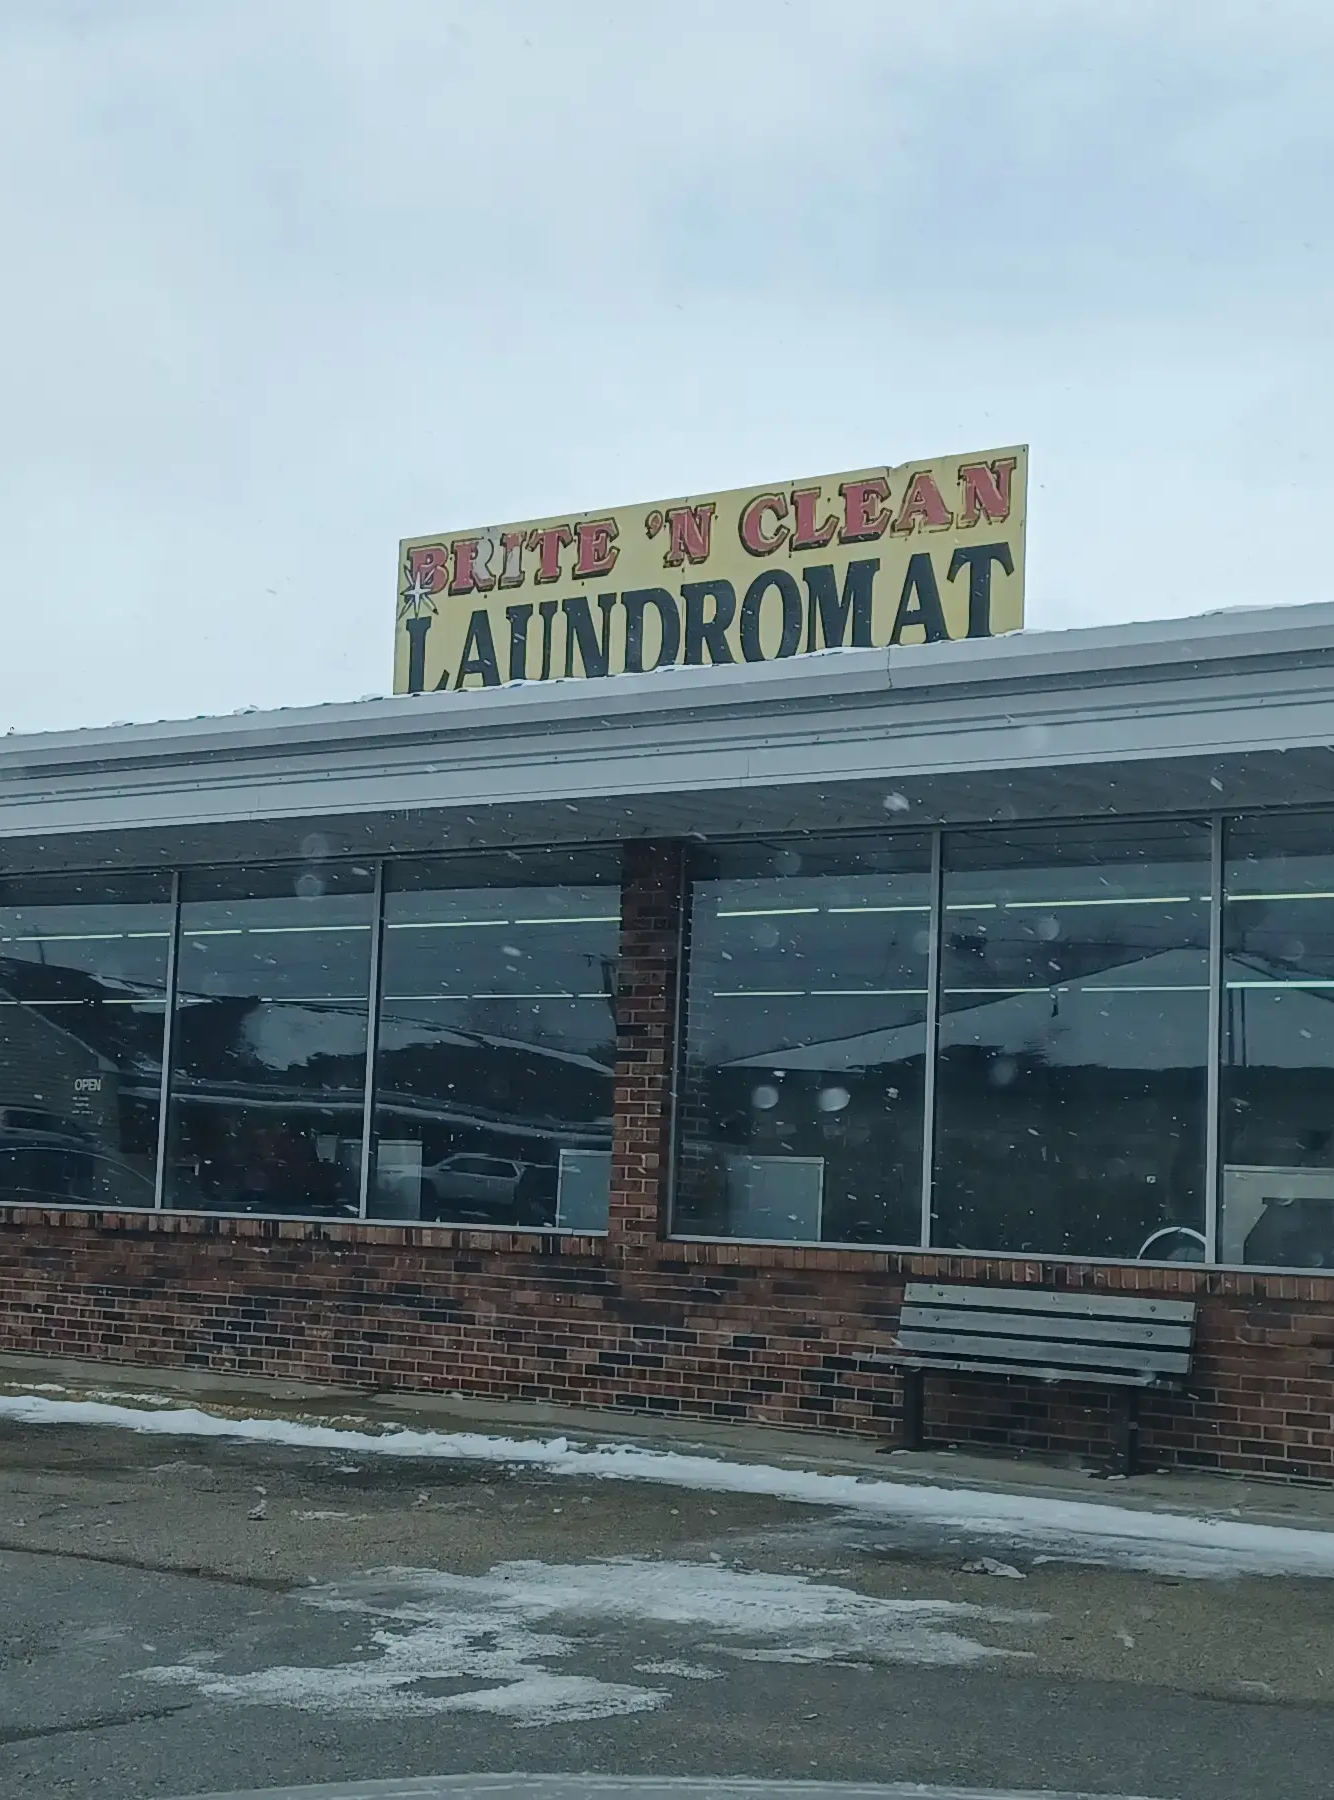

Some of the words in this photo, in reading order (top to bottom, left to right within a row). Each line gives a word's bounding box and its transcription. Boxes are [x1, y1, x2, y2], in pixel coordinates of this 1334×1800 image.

[407, 516, 620, 597] BRITE
[738, 457, 1017, 557] CLEAN
[405, 541, 1015, 695] LAUNDROMAT
[74, 1078, 102, 1091] OPEN
